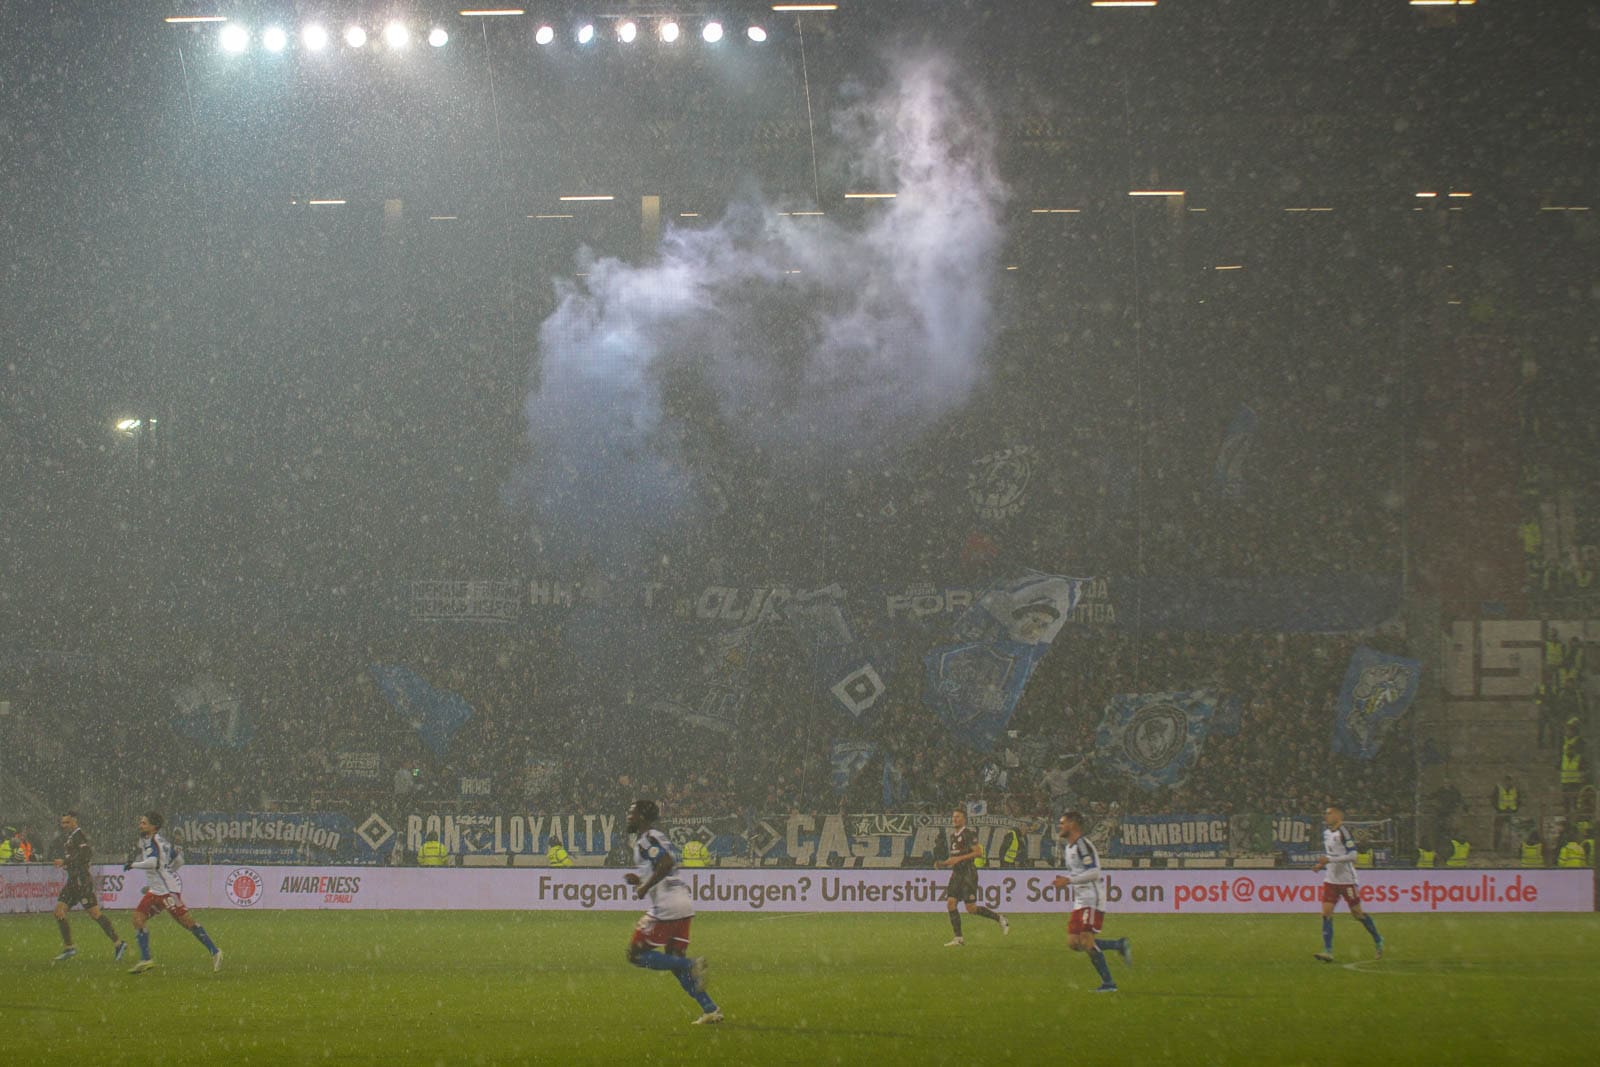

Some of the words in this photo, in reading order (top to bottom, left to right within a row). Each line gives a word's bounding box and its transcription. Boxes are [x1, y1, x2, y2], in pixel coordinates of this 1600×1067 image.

[173, 818, 341, 852] olksparkstadion
[495, 815, 615, 853] LOYALTY
[280, 876, 361, 893] AWARENESS
[685, 874, 811, 909] ldungen?
[821, 877, 1016, 909] Unterstützg?
[1131, 885, 1164, 902] an
